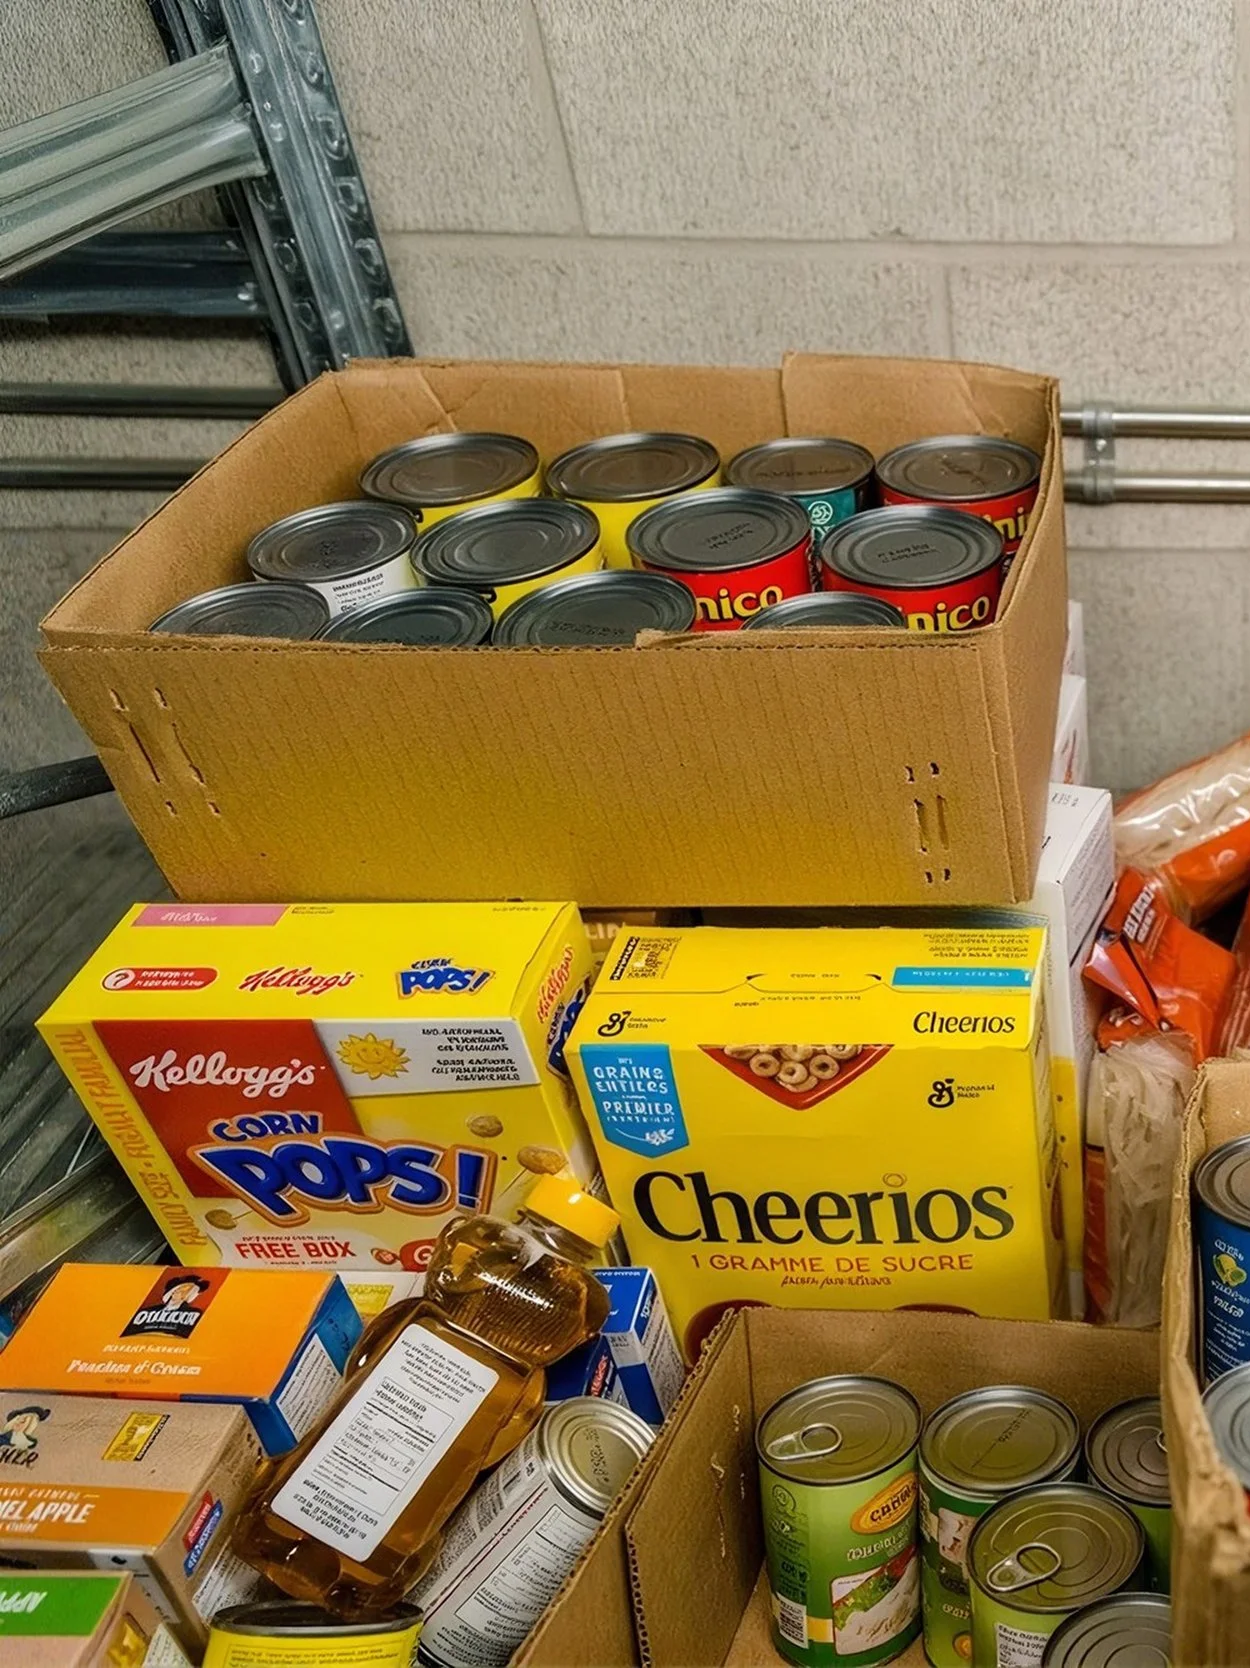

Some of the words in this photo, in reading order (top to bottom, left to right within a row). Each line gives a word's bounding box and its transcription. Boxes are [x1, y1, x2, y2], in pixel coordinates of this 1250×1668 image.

[695, 585, 783, 621] nico
[905, 595, 990, 633] nico
[400, 966, 491, 996] POPS!
[912, 1011, 1016, 1034] Cheerios
[129, 1049, 315, 1098] Kellogg's
[212, 1112, 319, 1142] CORN
[198, 1138, 490, 1218] POPS!
[633, 1171, 1015, 1245] Cheerios
[235, 1241, 301, 1260] FREE
[301, 1240, 357, 1259] BOX
[708, 1254, 826, 1273] GRAMME
[836, 1256, 872, 1273] DE
[882, 1253, 974, 1273] SUCRE
[28, 1502, 96, 1524] APPLE
